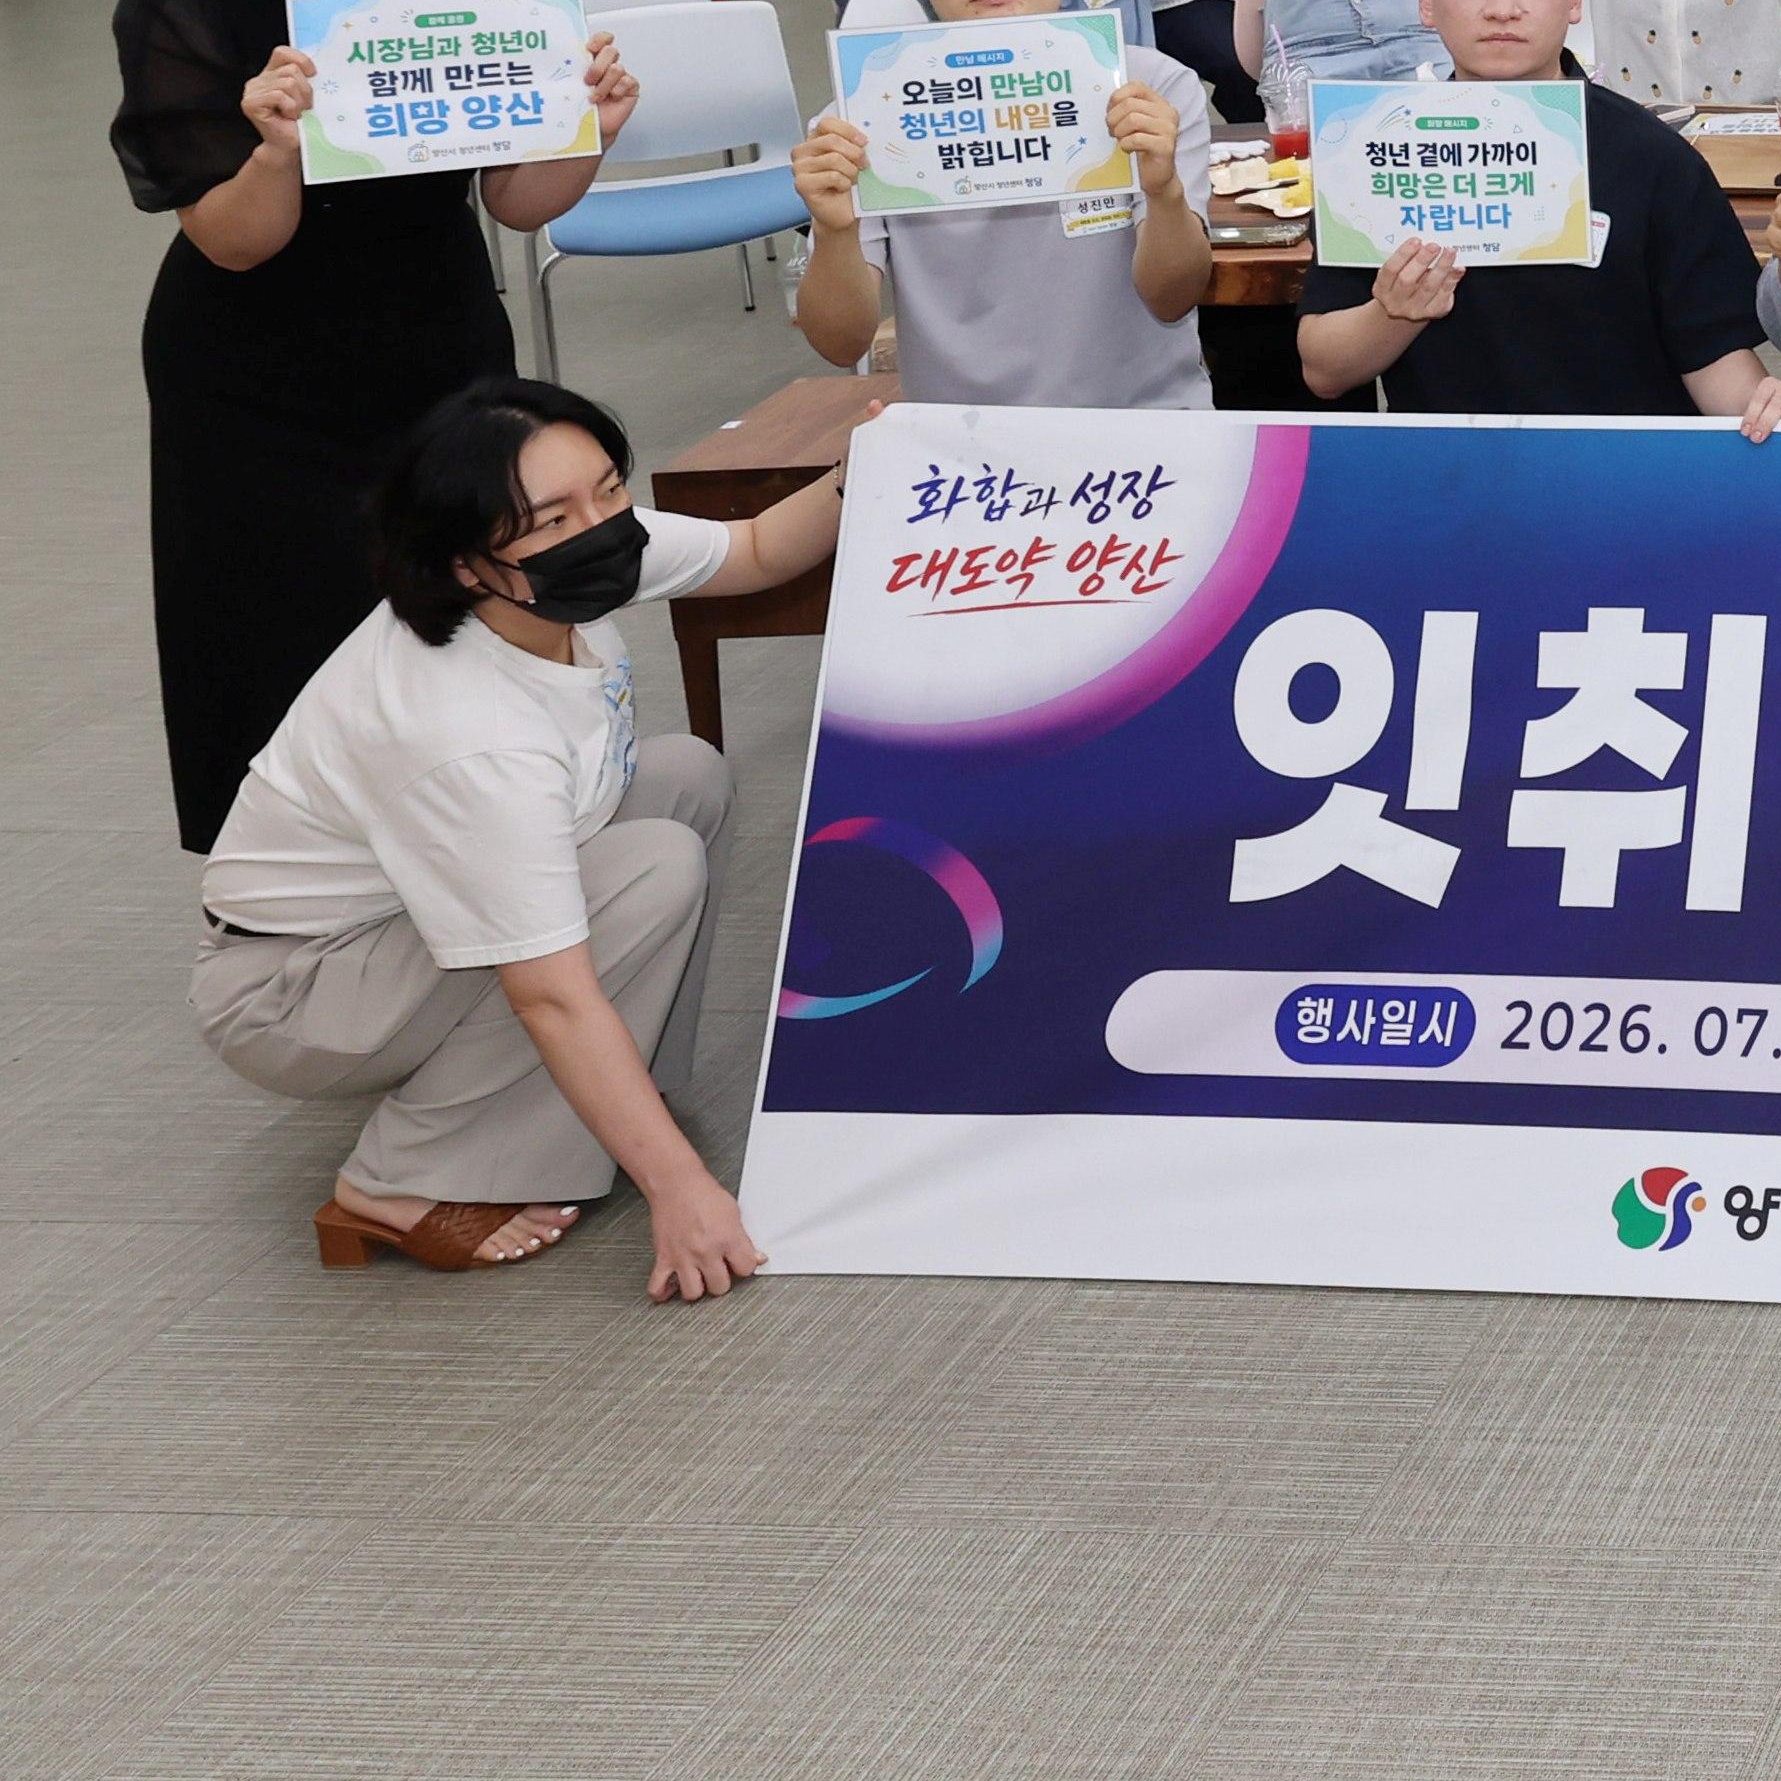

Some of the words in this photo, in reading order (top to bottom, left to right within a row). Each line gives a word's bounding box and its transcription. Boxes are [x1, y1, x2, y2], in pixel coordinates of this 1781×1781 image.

[347, 35, 461, 64] 시장님과
[471, 30, 548, 56] 청년이
[955, 53, 975, 65] 만남
[977, 51, 1005, 64] 메시지
[368, 67, 433, 98] 함께
[446, 62, 534, 91] 만드는
[902, 76, 982, 107] 오늘의
[989, 69, 1073, 100] 만남이
[365, 100, 450, 138] 희망
[462, 91, 545, 130] 양산
[899, 108, 986, 141] 청년의
[994, 100, 1079, 131] 내일을
[938, 135, 1052, 172] 밝힙니다
[1365, 141, 1410, 167] 청년
[1416, 141, 1463, 167] 곁에
[1468, 141, 1538, 167] 가까이
[1370, 172, 1447, 200] 희망은
[1453, 172, 1477, 198] 더
[1484, 171, 1535, 197] 크게
[1400, 203, 1513, 232] 자랍니다
[906, 467, 1063, 525] 화합과
[1068, 463, 1177, 520] 성장
[885, 534, 1058, 602] 대도약
[1062, 534, 1185, 599] 양산
[1295, 996, 1456, 1048] 행사일시
[1499, 1000, 1667, 1057] 2026.
